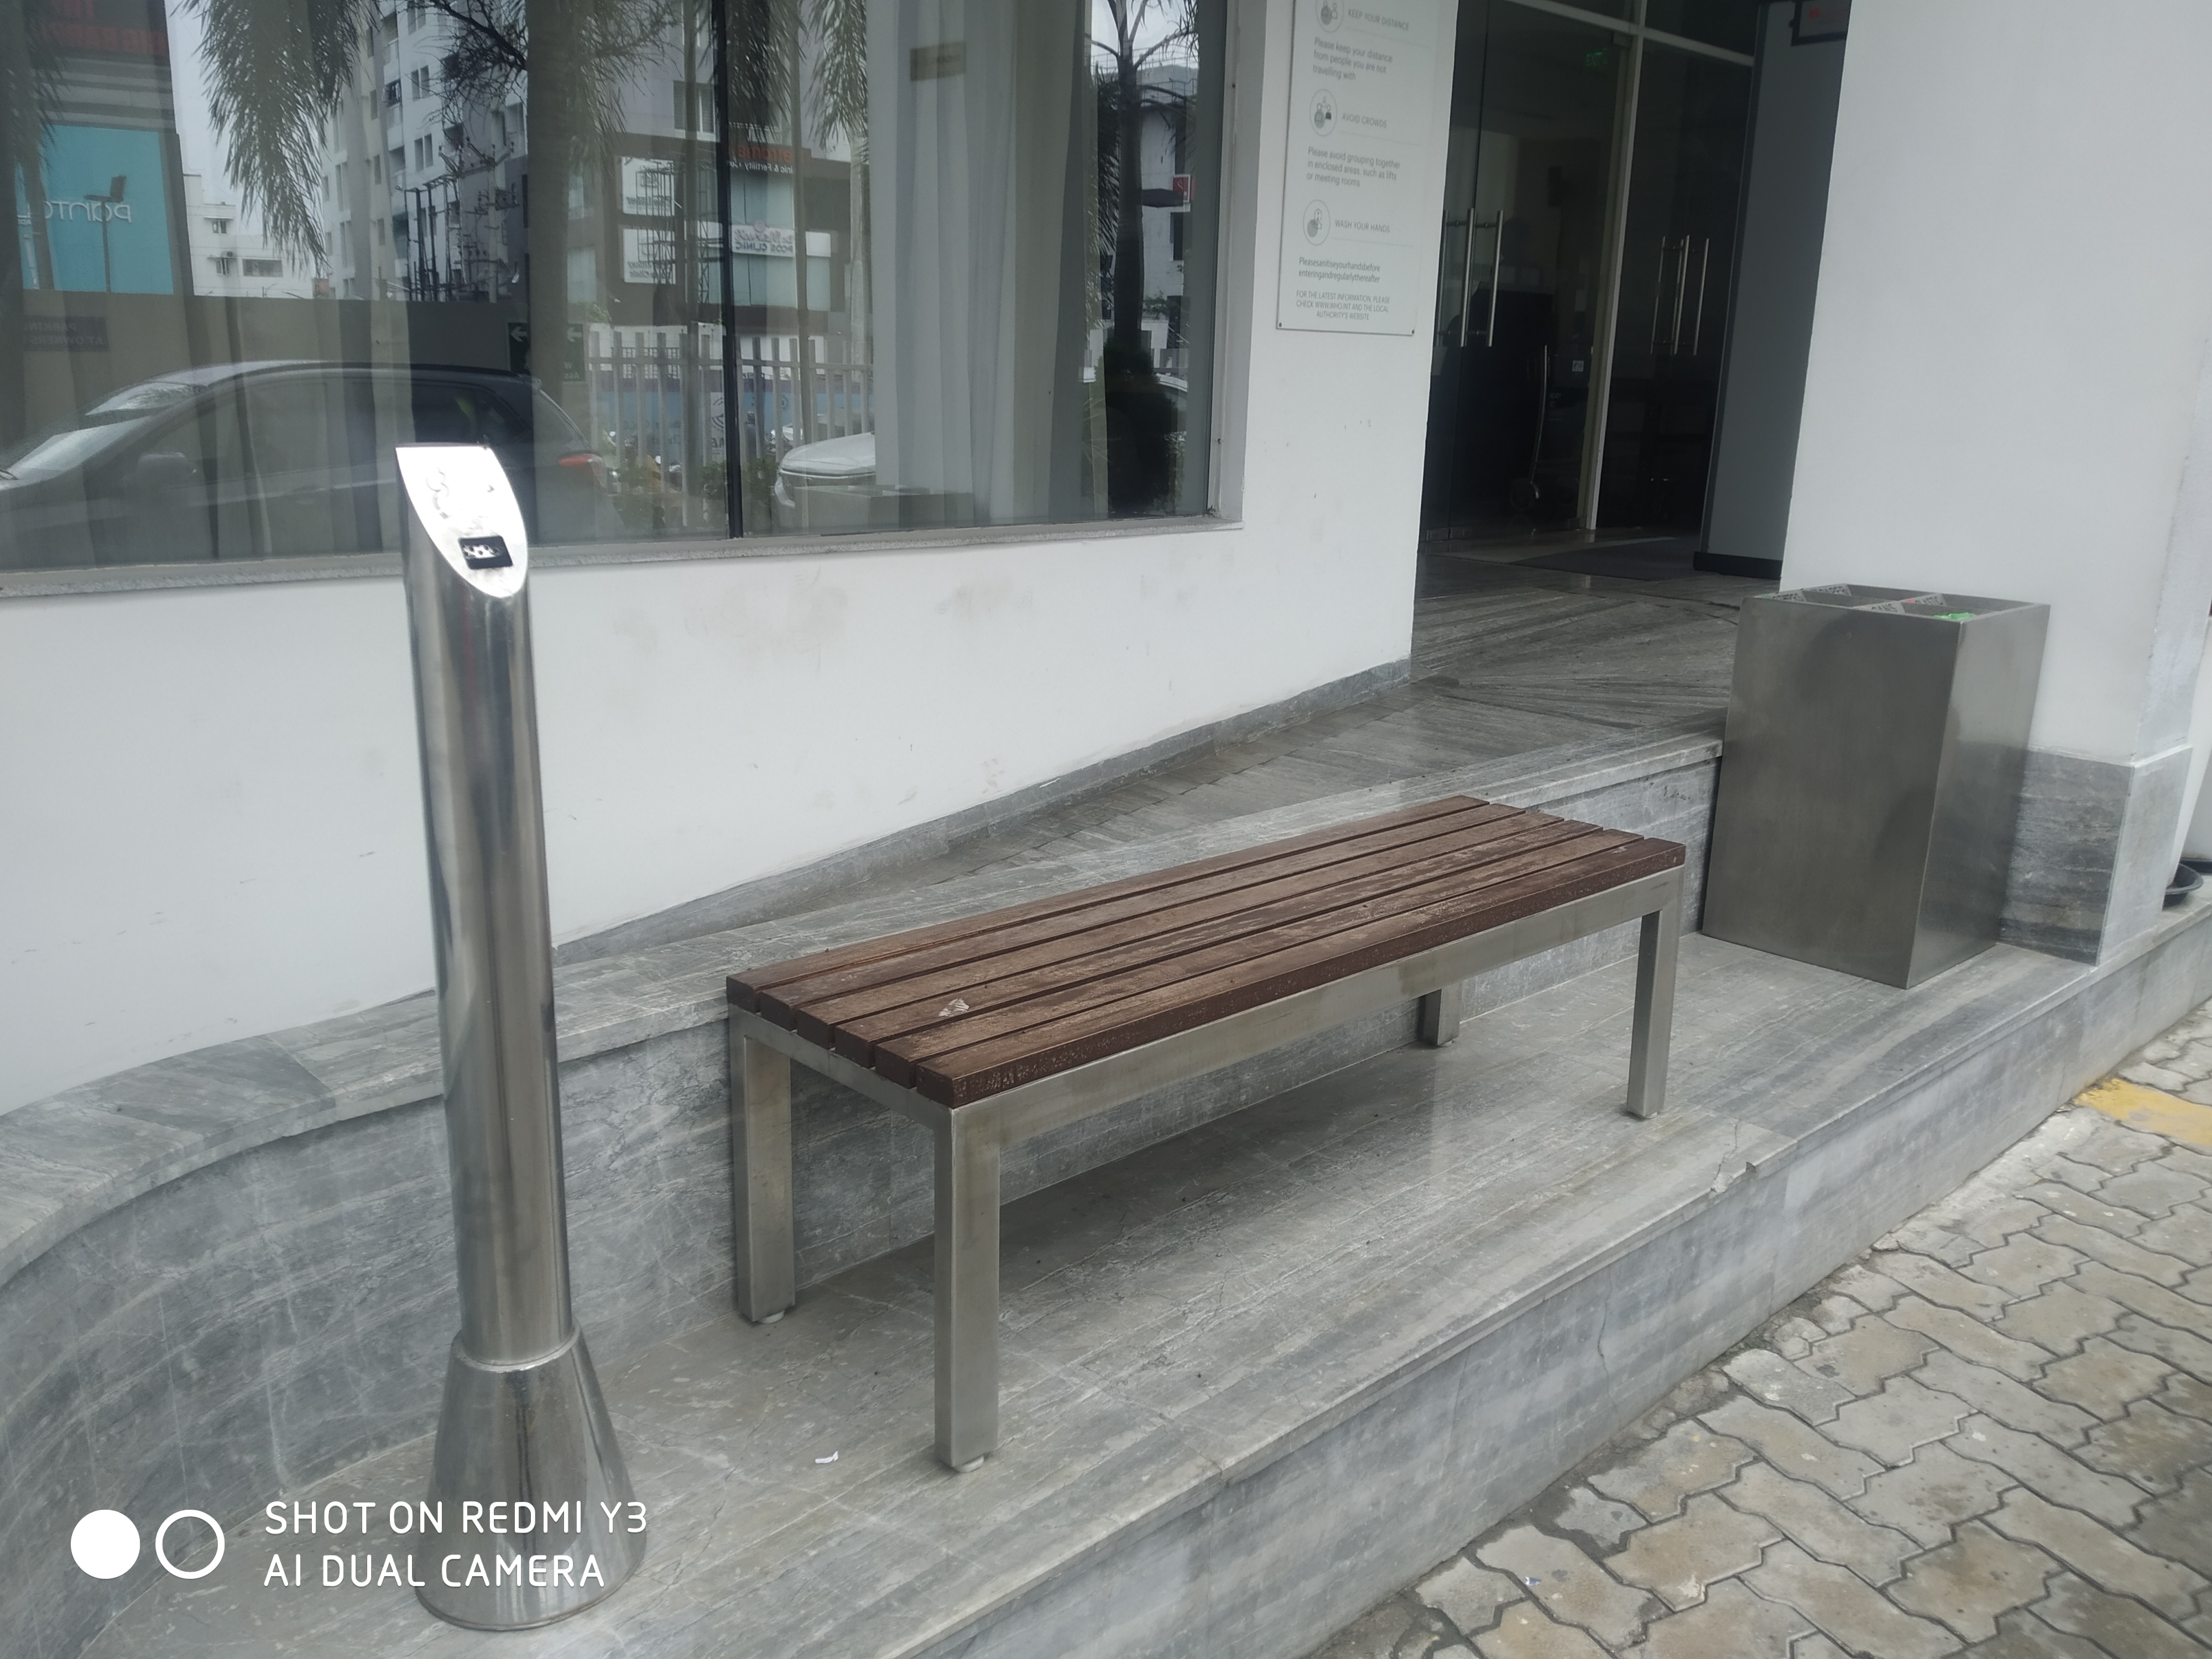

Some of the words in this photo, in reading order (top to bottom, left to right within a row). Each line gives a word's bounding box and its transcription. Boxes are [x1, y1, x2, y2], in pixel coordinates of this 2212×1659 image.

[1348, 9, 1363, 19] KEEP
[1364, 12, 1380, 23] YOUR
[1381, 17, 1409, 31] DISTANCE
[1314, 37, 1334, 50] Please
[1335, 42, 1351, 54] keep
[1353, 48, 1366, 57] your
[1367, 50, 1392, 63] distance
[1313, 50, 1328, 61] from
[1330, 55, 1352, 67] people
[1353, 60, 1365, 69] you
[1376, 65, 1386, 74] not
[1313, 65, 1342, 80] travelling
[1343, 71, 1356, 80] with
[1342, 113, 1360, 123] AVOID
[1361, 116, 1387, 128] CROWDS
[1308, 146, 1328, 157] Please
[1329, 149, 1346, 161] avoid
[1347, 153, 1374, 166] grouping
[1375, 158, 1400, 169] together
[1314, 161, 1343, 173] enclosed
[1363, 167, 1377, 177] such
[1386, 170, 1397, 180] lifts
[1314, 173, 1340, 185] meeting
[1341, 178, 1360, 187] rooms
[1335, 220, 1353, 228] WASH
[1354, 222, 1369, 231] YOUR
[1370, 223, 1390, 233] HANDS
[1296, 300, 1314, 308] CHECK
[1318, 292, 1336, 300] LATEST
[1373, 296, 1390, 304] PLEASE
[1316, 311, 1349, 319] AUTHORITY'S
